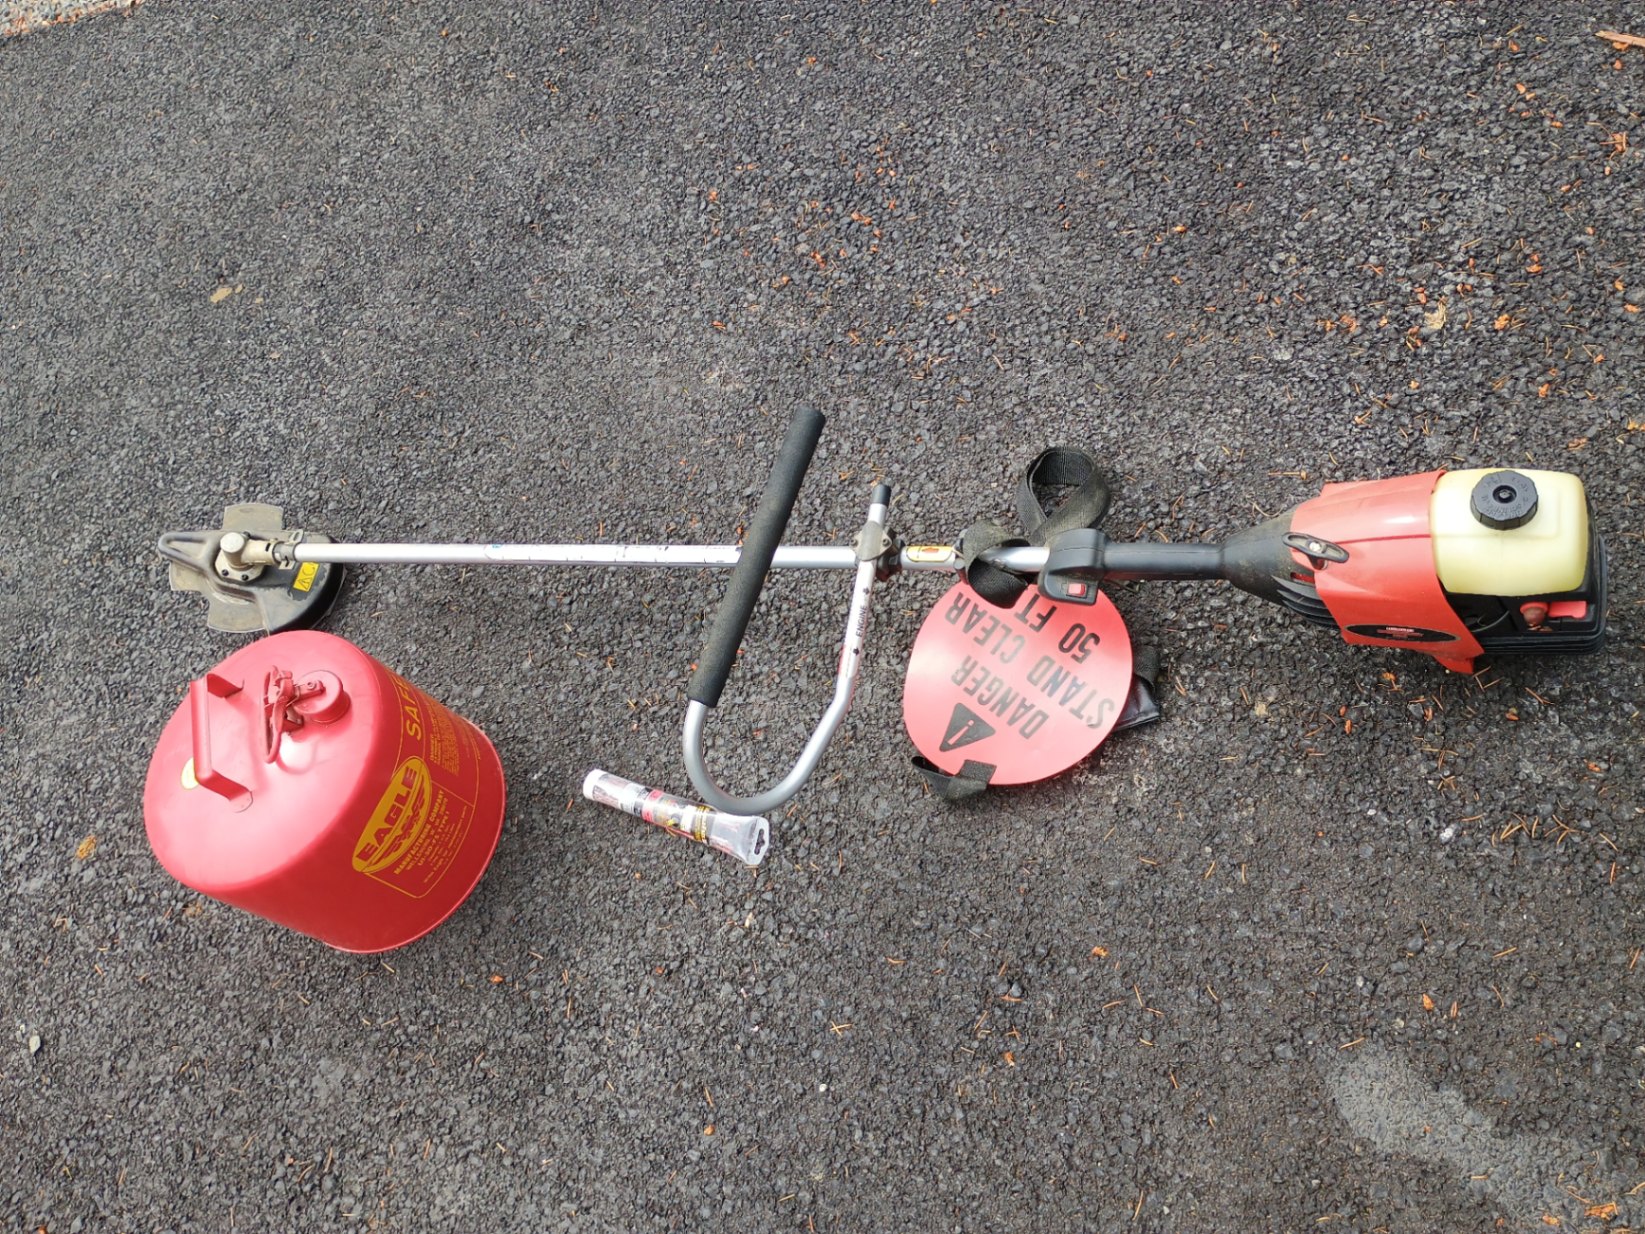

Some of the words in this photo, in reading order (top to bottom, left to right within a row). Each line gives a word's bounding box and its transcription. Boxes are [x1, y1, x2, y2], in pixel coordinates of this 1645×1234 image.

[855, 604, 868, 637] ENGINE
[944, 592, 1026, 664] CLEAR
[1013, 593, 1057, 633] FT
[1058, 623, 1101, 665] 50
[950, 655, 1049, 739] DANGER
[1026, 655, 1115, 729] STAND
[355, 765, 418, 862] EAGLE
[428, 789, 445, 822] COMPANY
